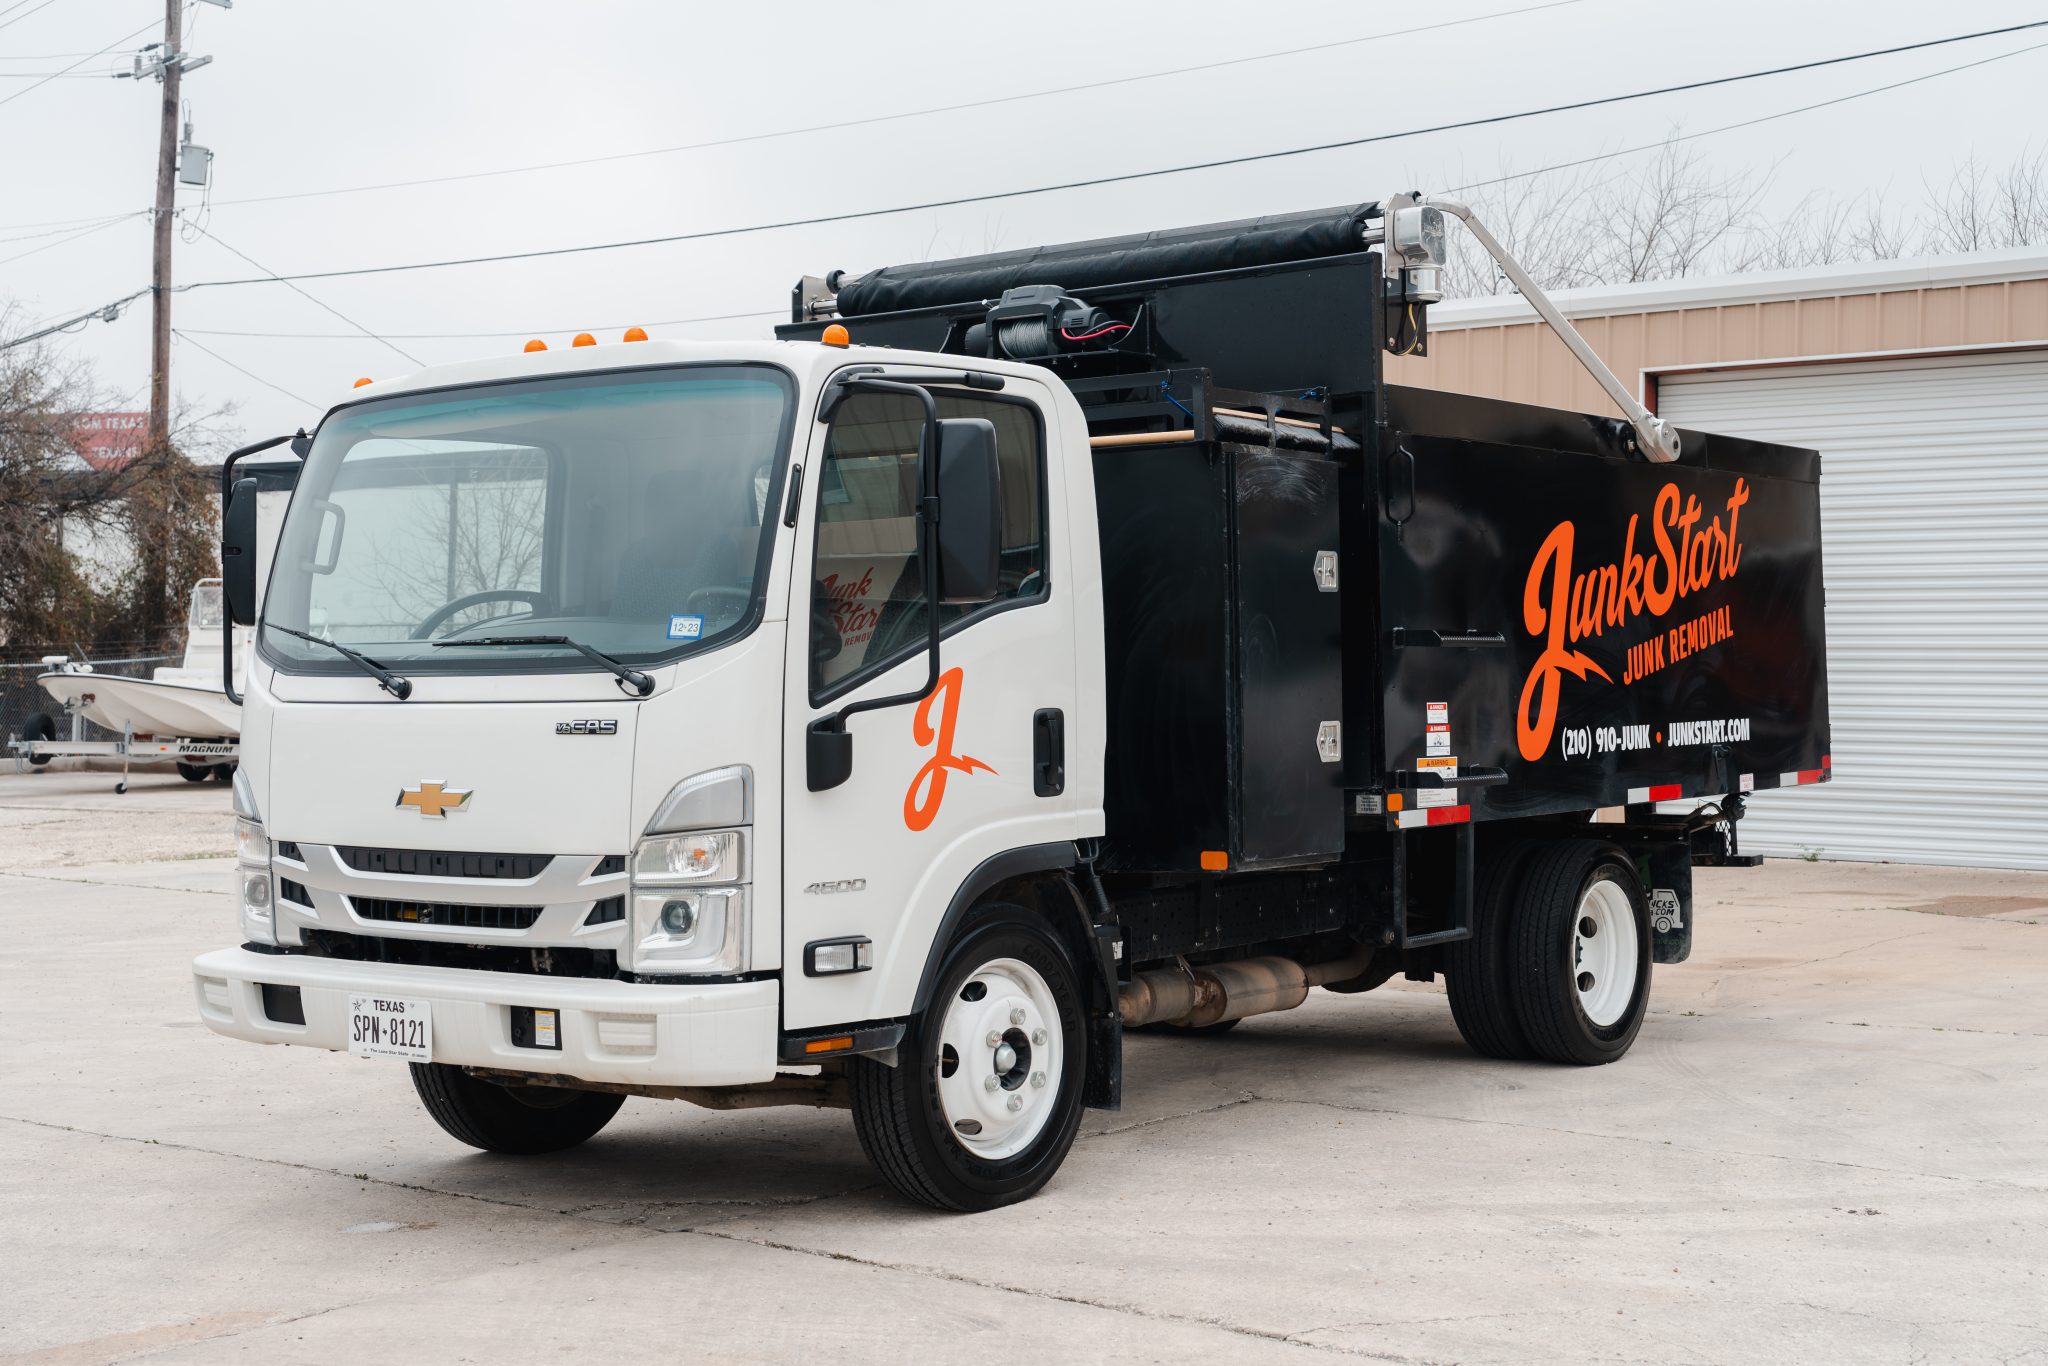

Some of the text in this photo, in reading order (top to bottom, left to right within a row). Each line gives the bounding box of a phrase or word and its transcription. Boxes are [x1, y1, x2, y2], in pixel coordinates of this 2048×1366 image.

[1516, 477, 1749, 761] JunkStart
[844, 631, 871, 647] REMOV
[1623, 605, 1734, 685] JUNK REMOVAL
[571, 719, 618, 735] GAS
[1562, 718, 1750, 761] (210) 910-JUNK JUNKSTART.COM
[179, 745, 234, 754] MAGNUM
[373, 1000, 405, 1013] TEXAS
